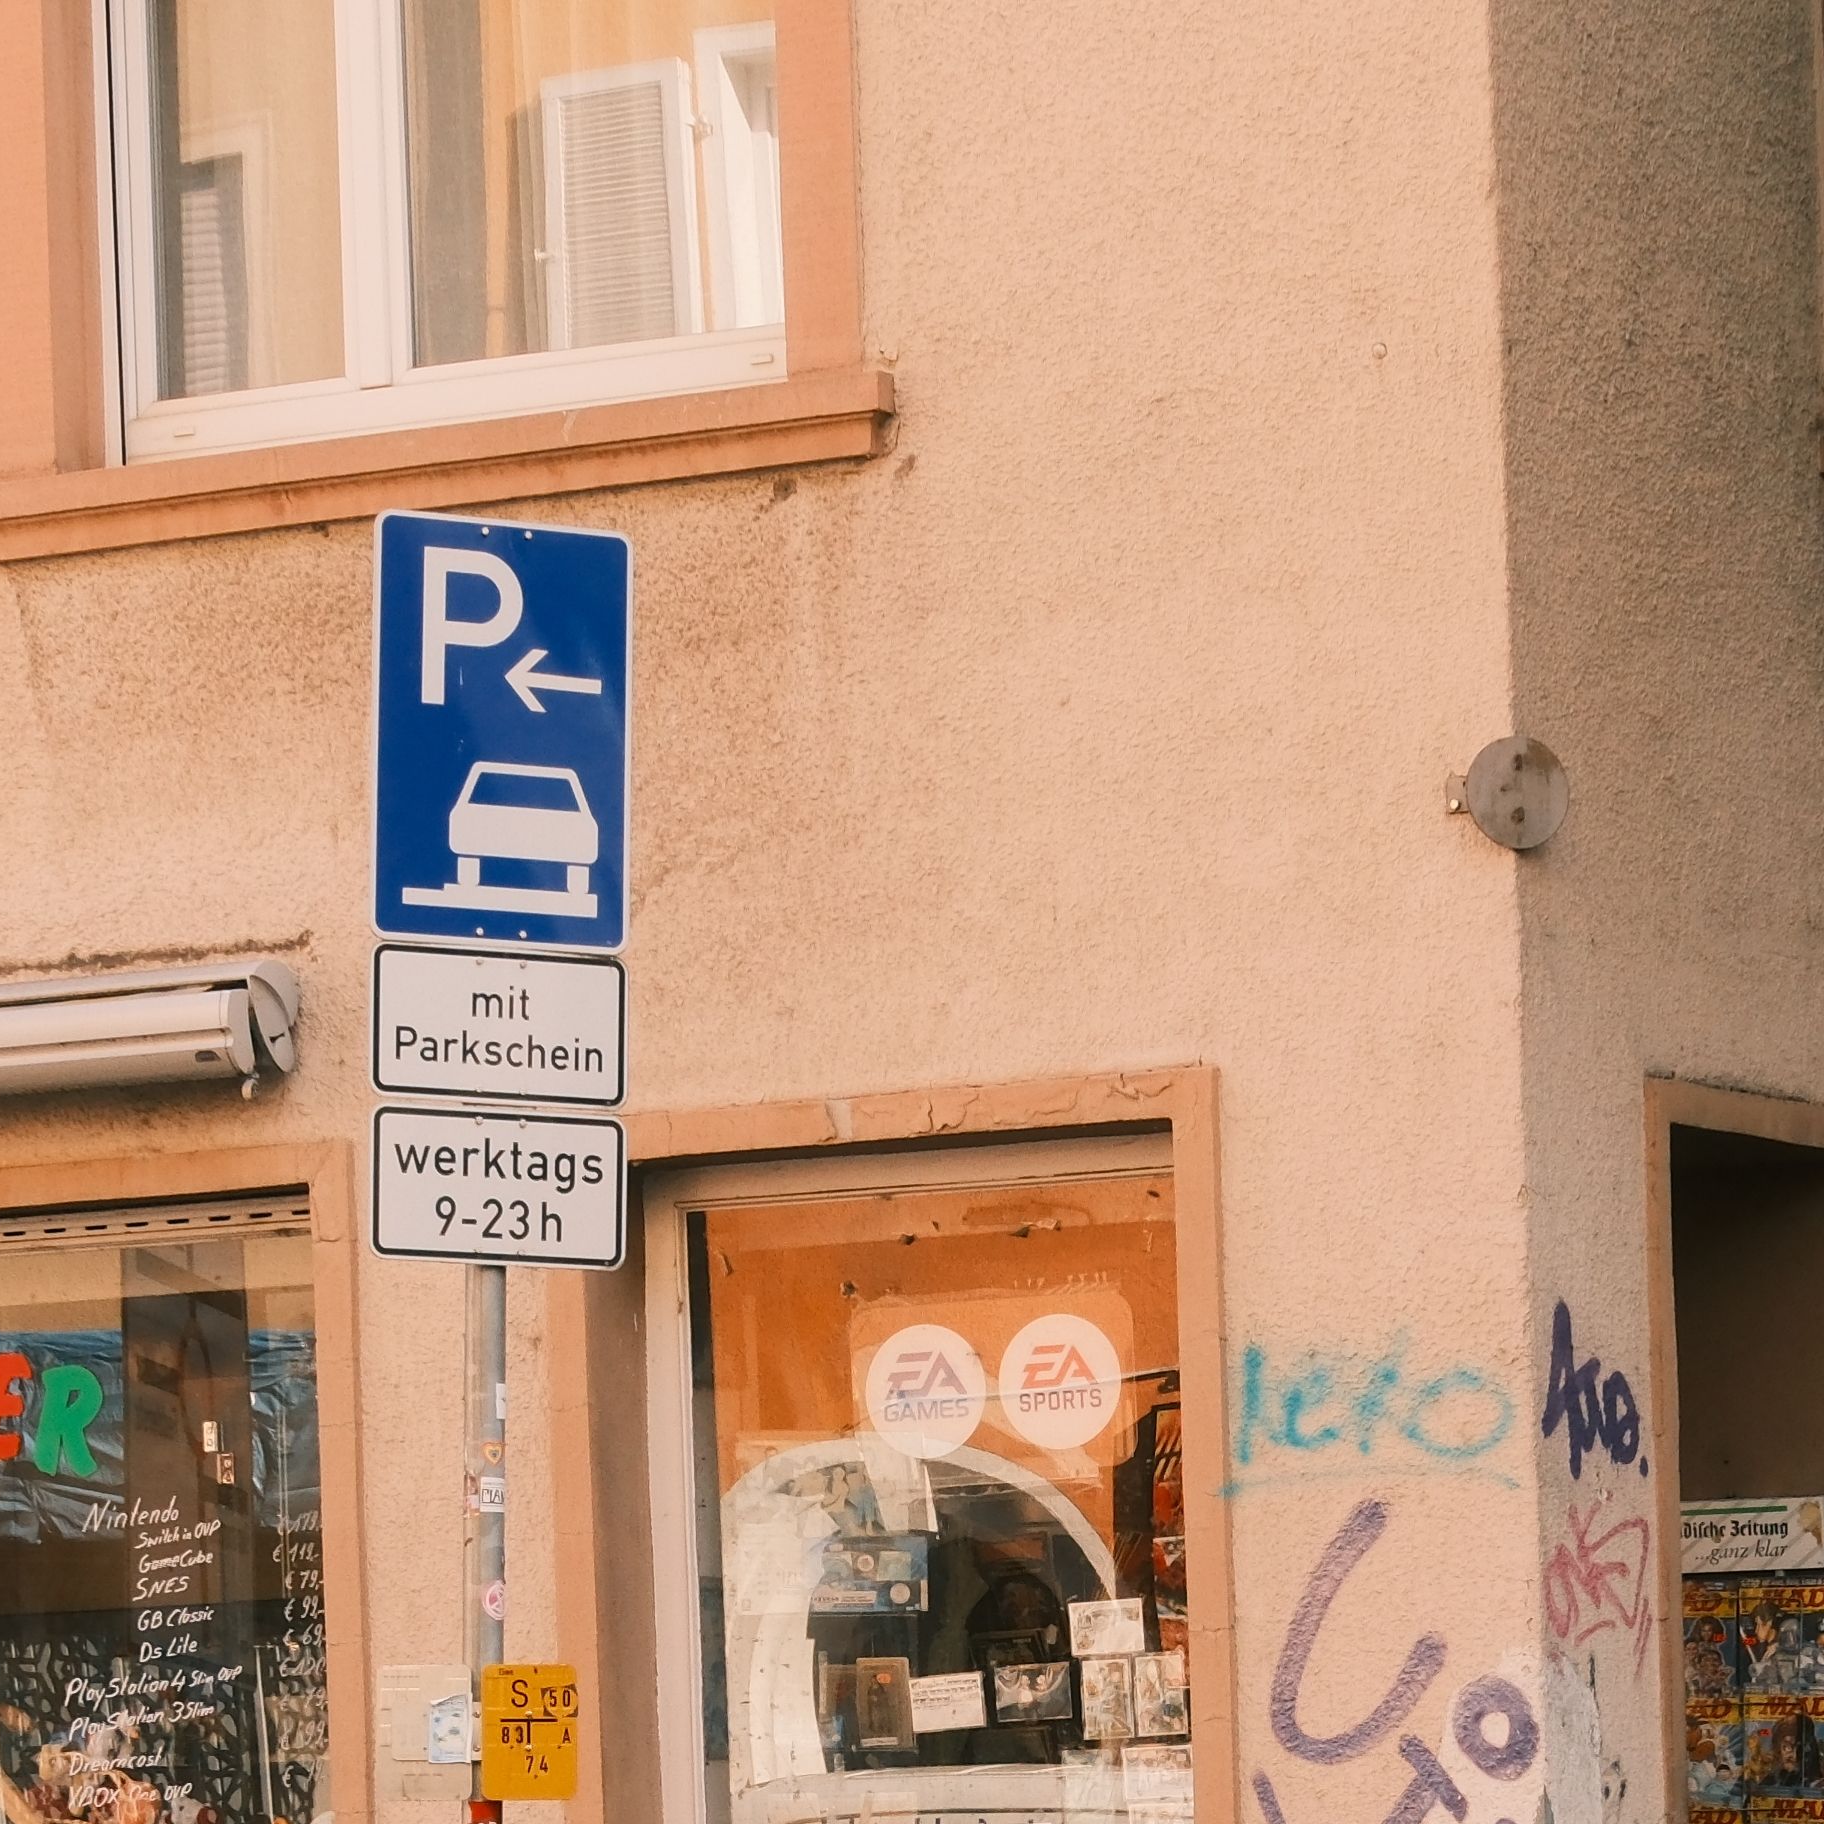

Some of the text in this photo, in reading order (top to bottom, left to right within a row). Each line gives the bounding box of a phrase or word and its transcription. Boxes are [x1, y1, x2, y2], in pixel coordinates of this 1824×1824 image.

[421, 546, 523, 704] P
[472, 986, 530, 1022] mit
[394, 1026, 604, 1073] Parkschein
[394, 1140, 604, 1194] werktags
[887, 1350, 967, 1399] EA
[1021, 1344, 1098, 1390] EA
[883, 1398, 969, 1423] GAMES
[1018, 1388, 1102, 1413] SPORTS
[82, 1496, 179, 1532] Nintendo
[1730, 1520, 1788, 1538] Zeitung
[134, 1527, 180, 1549] Switch
[194, 1519, 221, 1540] OVP
[1755, 1540, 1788, 1557] klar
[132, 1576, 189, 1601] SNES
[137, 1610, 163, 1631] GB
[166, 1606, 215, 1627] Classic
[511, 1679, 528, 1708] S
